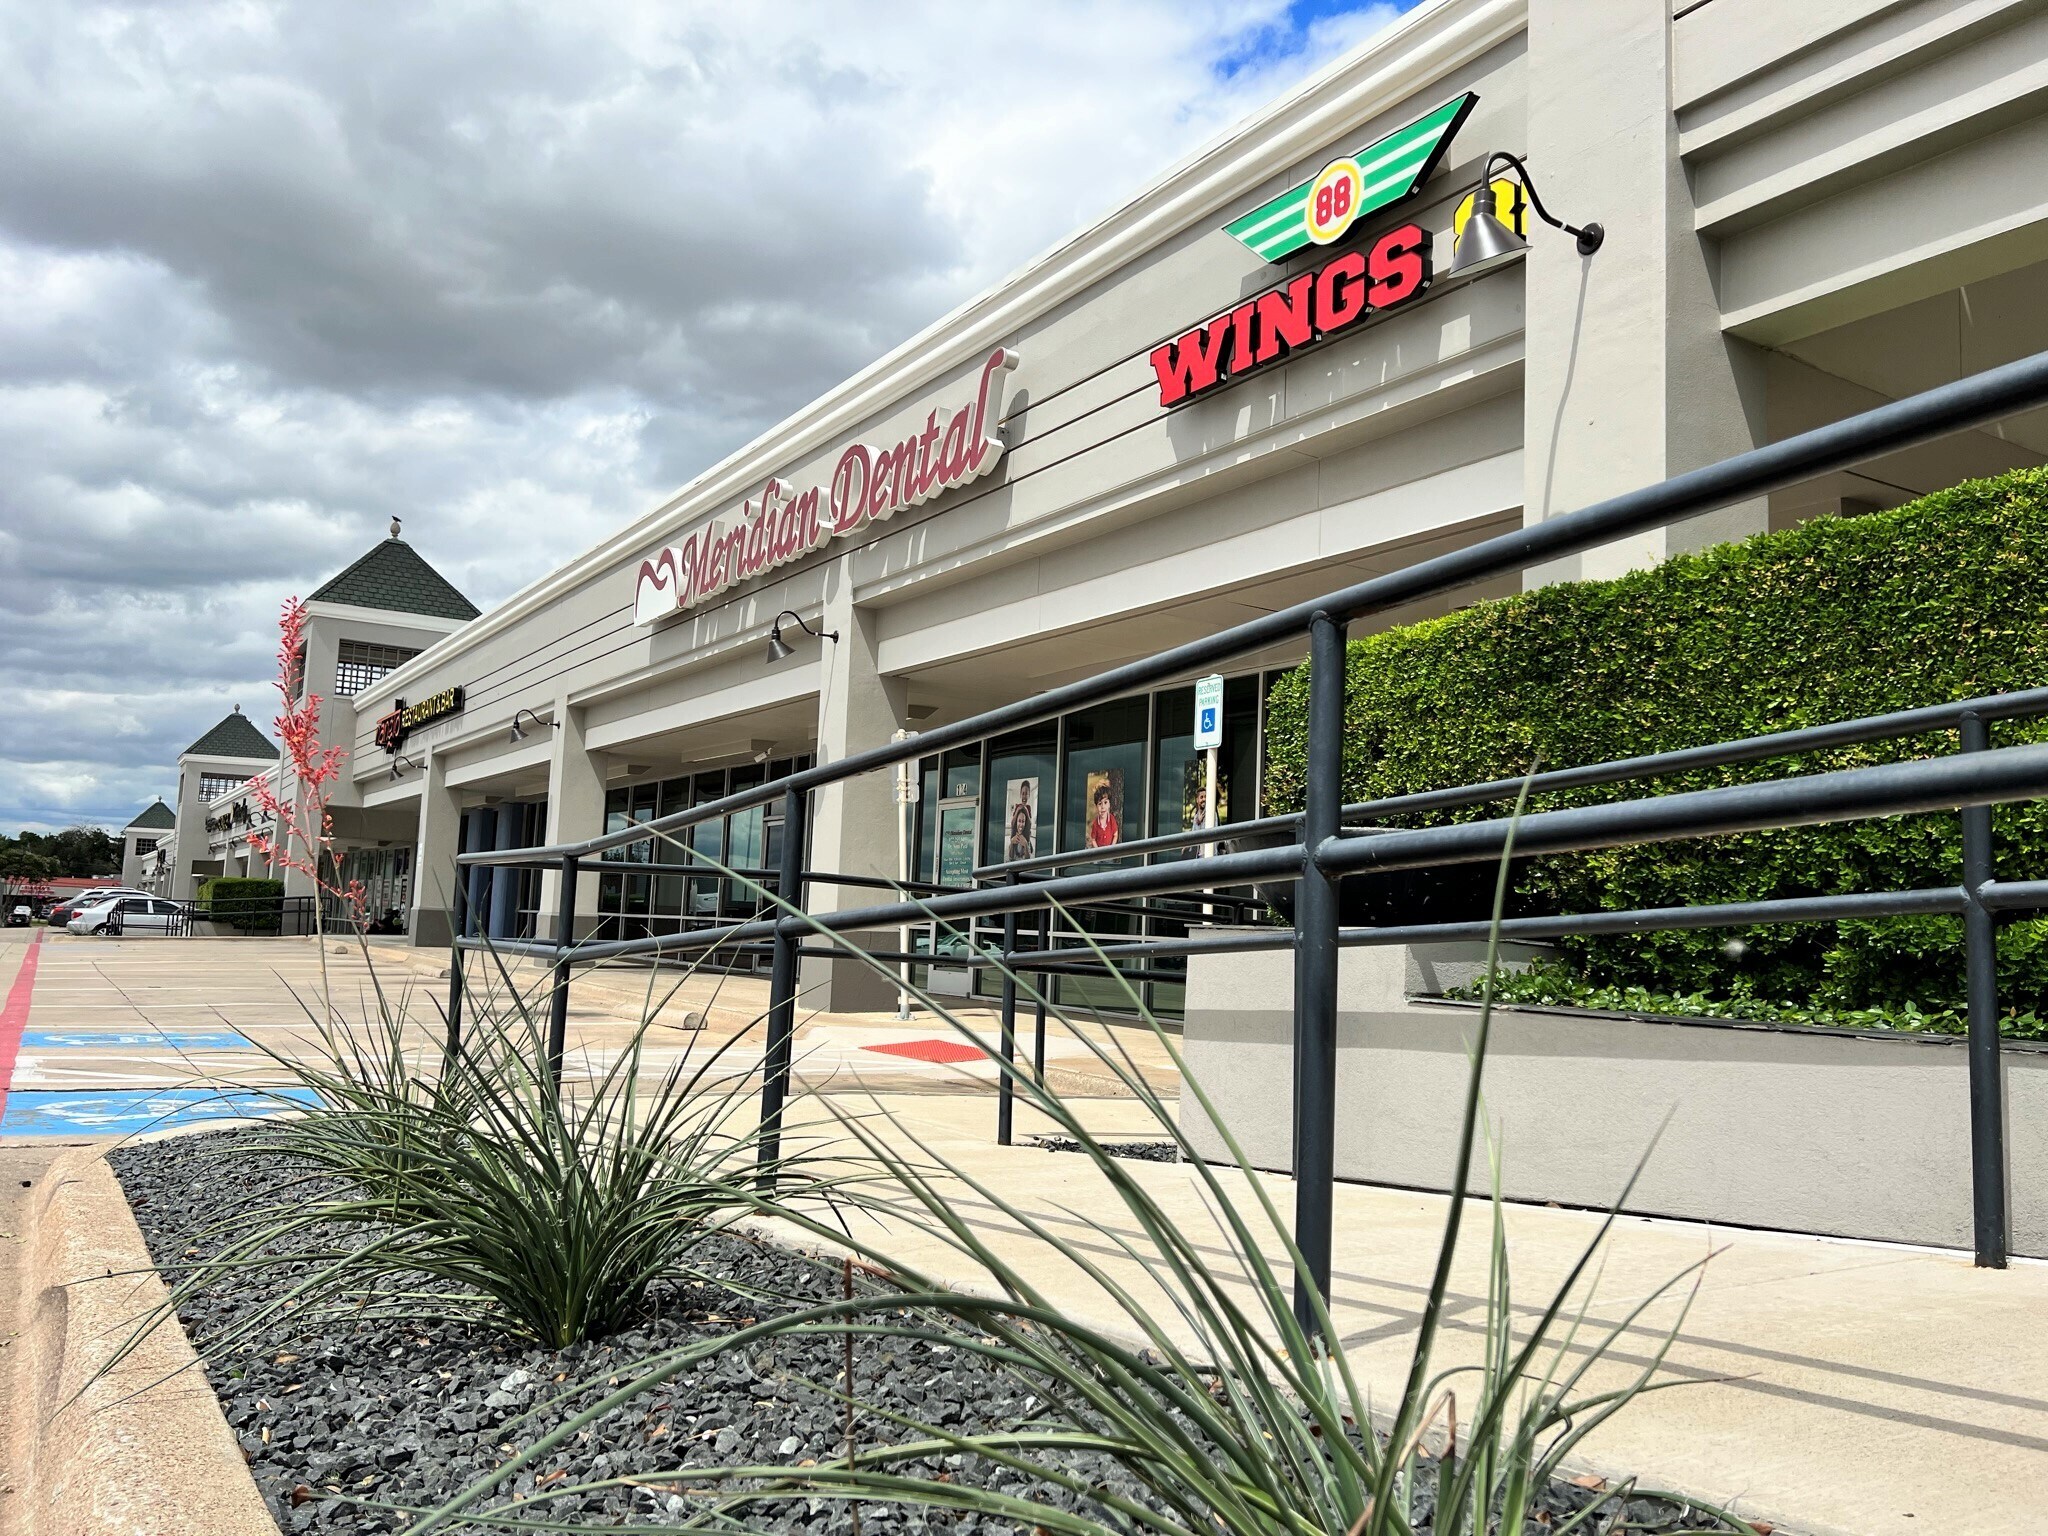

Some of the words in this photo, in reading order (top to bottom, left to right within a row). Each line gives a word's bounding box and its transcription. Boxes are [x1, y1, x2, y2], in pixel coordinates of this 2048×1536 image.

[1315, 175, 1352, 226] 88
[1150, 223, 1432, 408] WINGS
[677, 477, 826, 608] Meridian
[830, 347, 1014, 537] Dental
[402, 696, 437, 727] RESTAURANT
[441, 687, 455, 711] BAR
[1198, 683, 1221, 695] RESERVED
[1199, 695, 1219, 706] PARKING
